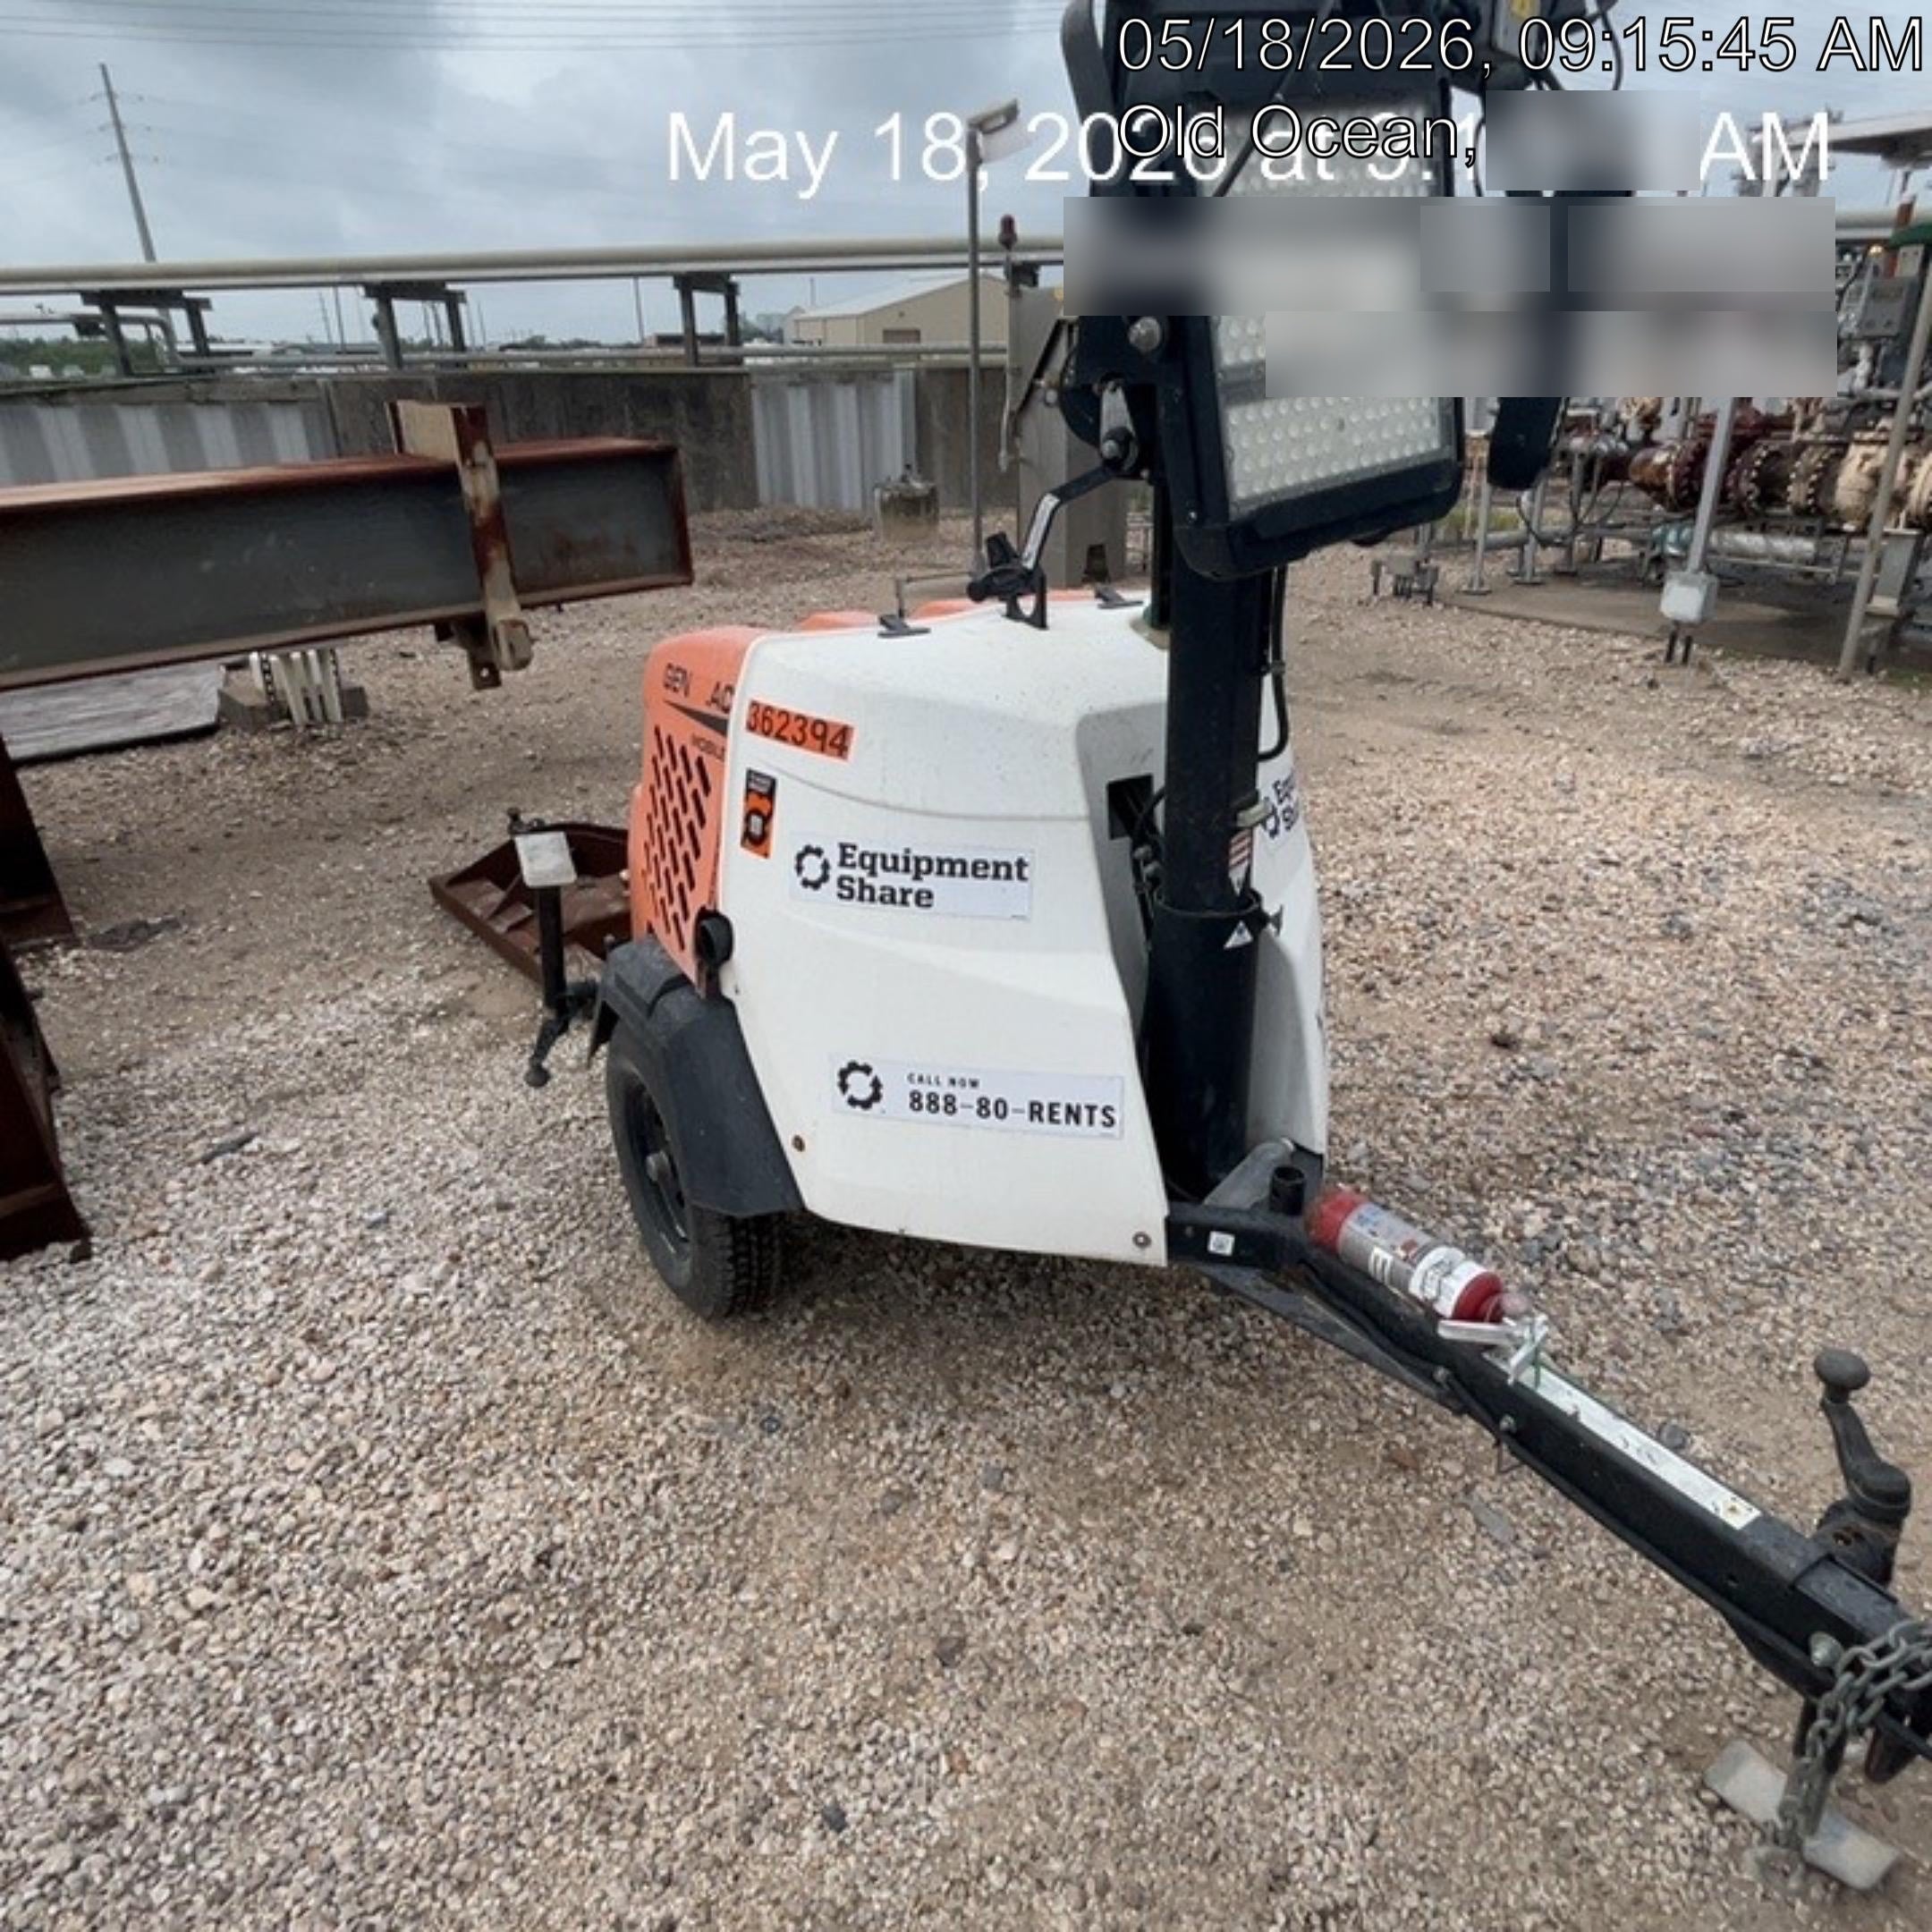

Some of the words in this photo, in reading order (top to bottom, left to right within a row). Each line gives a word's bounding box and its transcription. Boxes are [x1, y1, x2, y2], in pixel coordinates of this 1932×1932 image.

[746, 699, 849, 758] 362394
[836, 842, 1030, 882] Equipment
[835, 874, 935, 908] Share
[907, 1072, 941, 1087] CALL
[948, 1077, 980, 1089] NOW
[908, 1089, 1116, 1128] 888-80-RENTS
